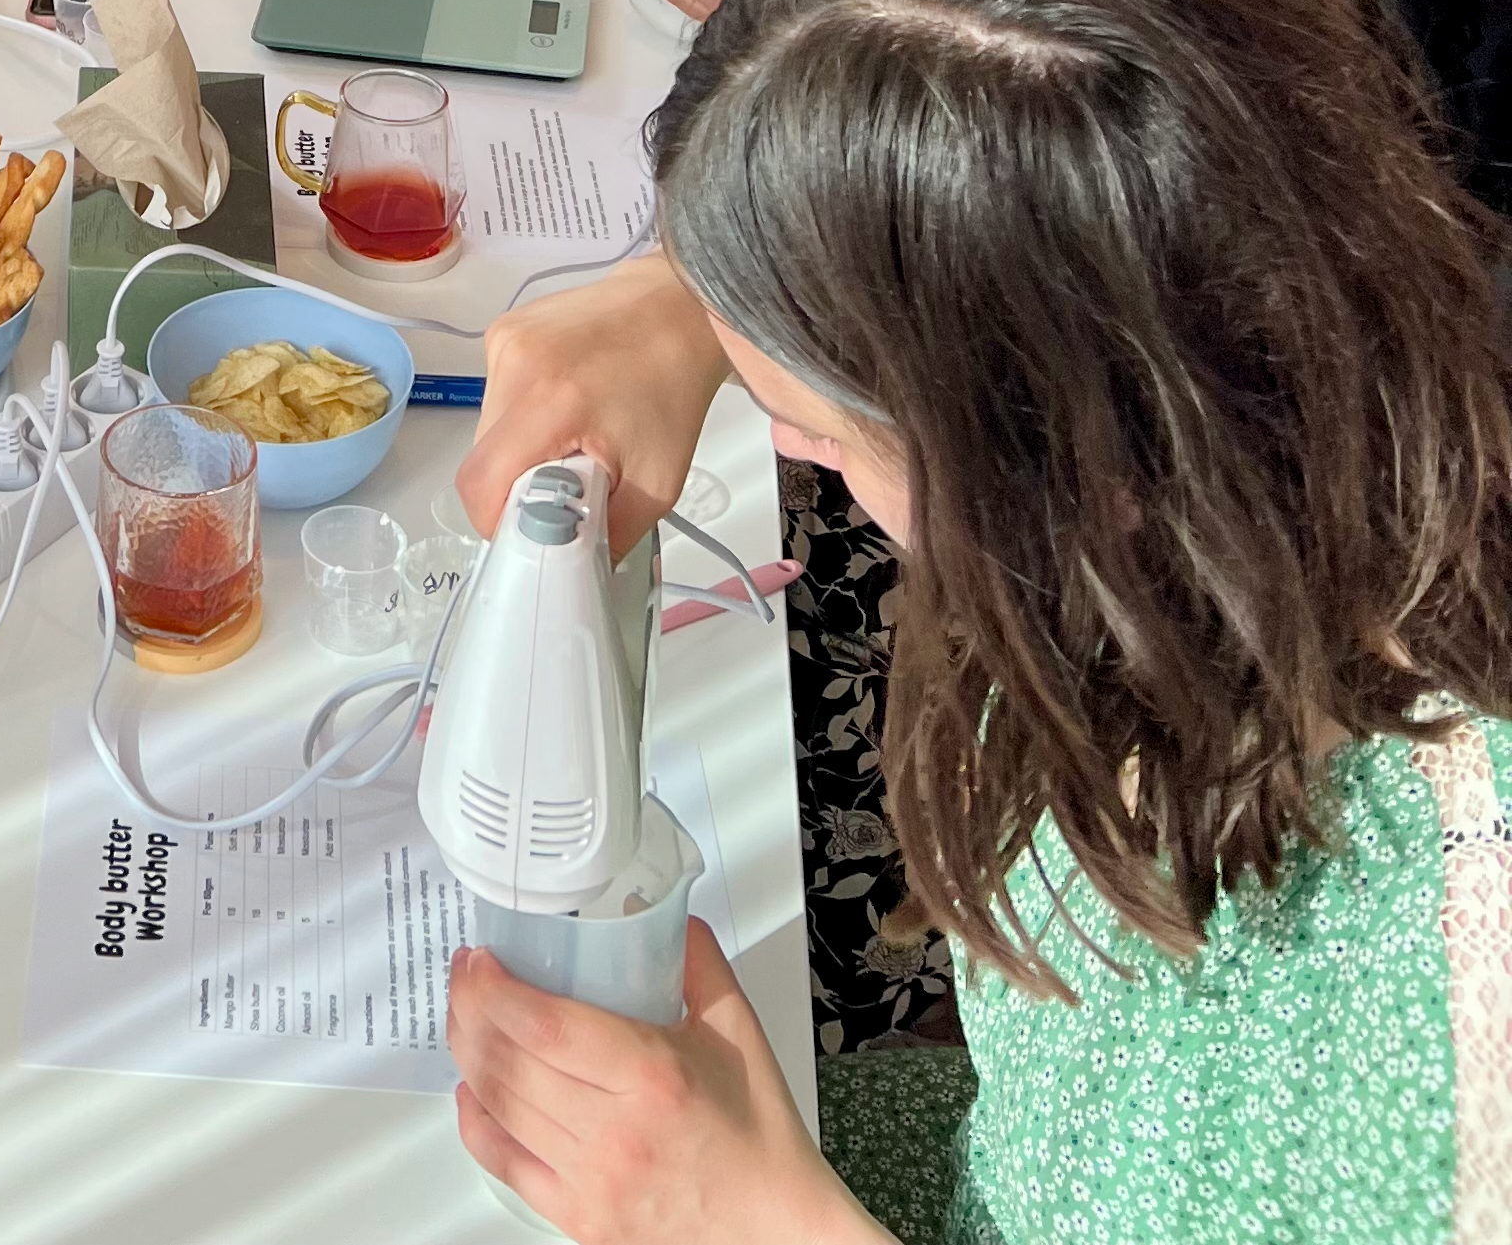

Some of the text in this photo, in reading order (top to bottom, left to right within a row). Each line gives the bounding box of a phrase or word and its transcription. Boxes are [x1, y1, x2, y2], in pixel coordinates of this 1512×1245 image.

[293, 129, 316, 166] butter
[448, 392, 483, 403] Perman
[94, 818, 138, 958] Body butter
[135, 833, 179, 941] Workshop
[251, 983, 260, 1007] butter
[276, 986, 286, 997] oil
[302, 991, 311, 1001] oil
[224, 1000, 236, 1029] Mango
[250, 1008, 260, 1031] Shea
[275, 998, 286, 1033] Coconut
[302, 1002, 312, 1035] Almond
[328, 994, 339, 1037] Fragrance
